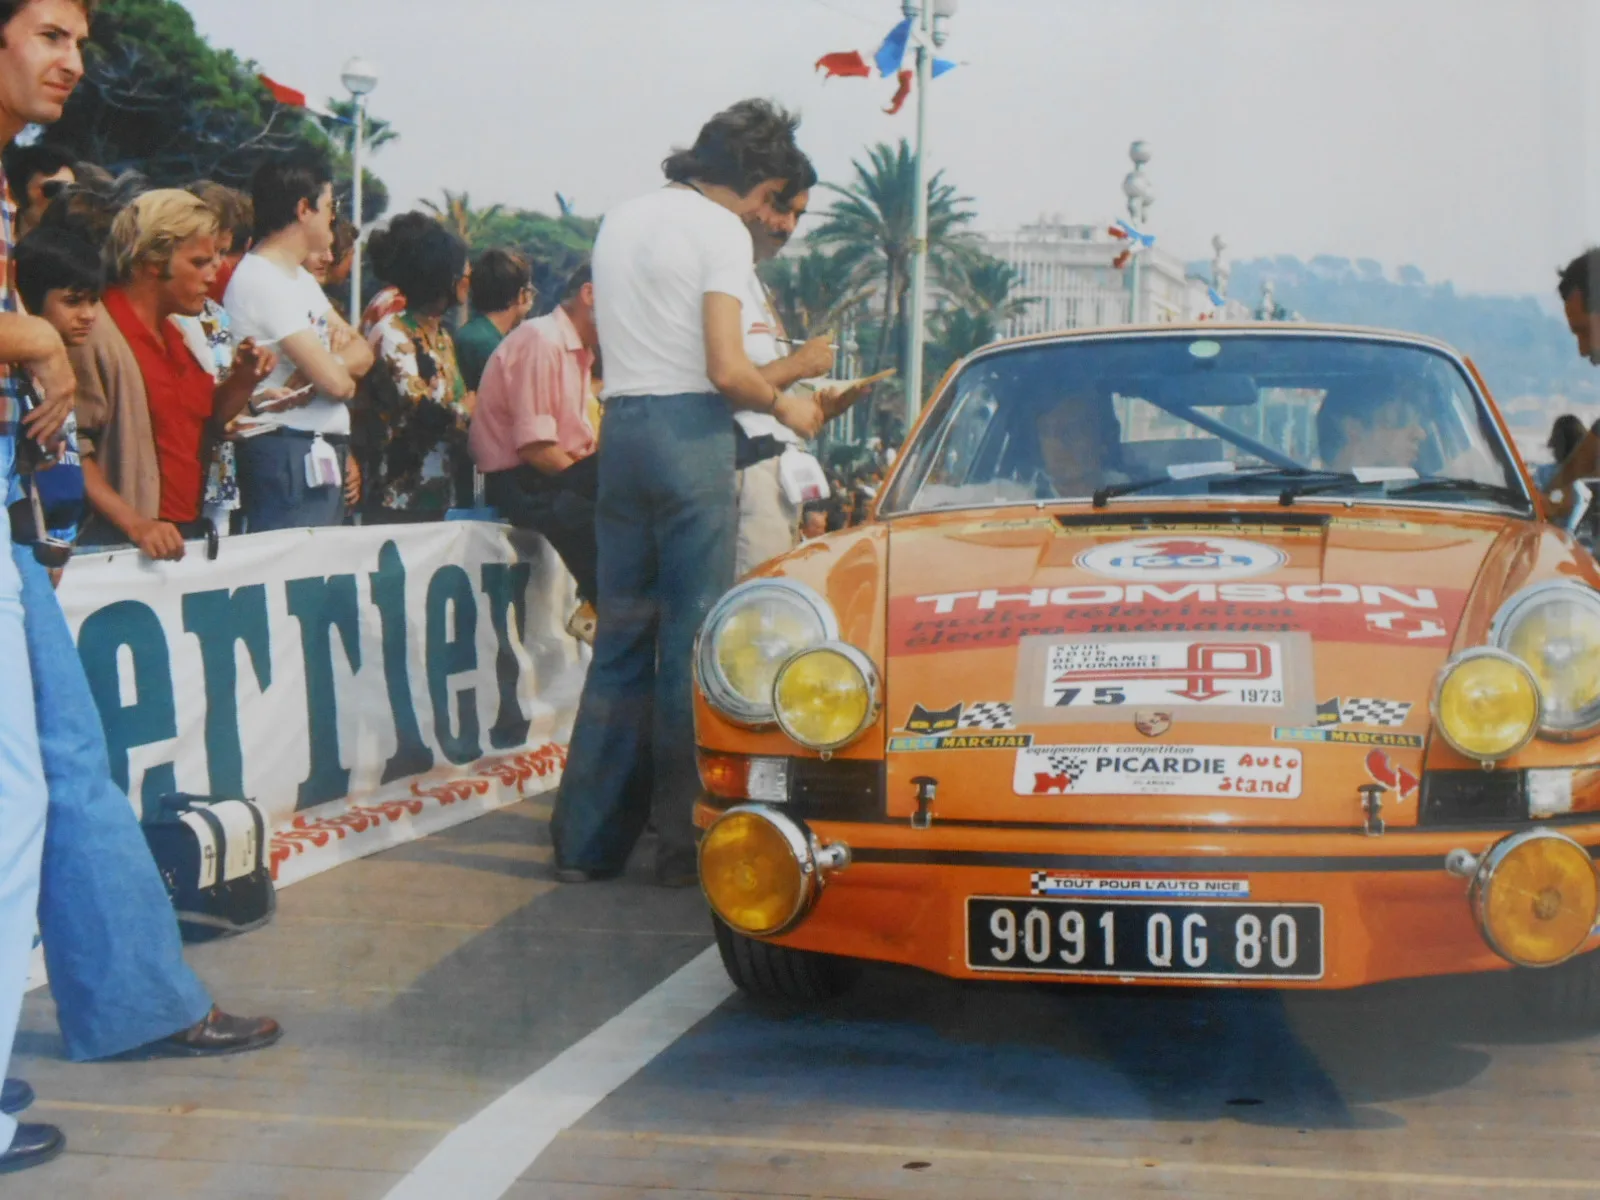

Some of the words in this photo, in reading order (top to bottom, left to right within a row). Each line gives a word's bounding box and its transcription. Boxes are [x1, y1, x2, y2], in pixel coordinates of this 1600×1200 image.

[916, 583, 1439, 615] THOMSON
[912, 610, 1041, 631] radio
[1052, 661, 1158, 671] AUTOMOBILE
[1082, 654, 1158, 662] FRANCE
[77, 539, 531, 822] errier
[1053, 686, 1126, 707] 75
[1239, 689, 1284, 704] 1973
[941, 734, 1027, 748] MARCHAL
[1330, 730, 1418, 746] MARCHAL
[1096, 756, 1226, 775] PICARDIE
[1237, 752, 1300, 769] Auto
[1217, 774, 1293, 794] stand
[1053, 879, 1094, 890] TOUT
[1100, 880, 1142, 891] POUR
[1145, 881, 1200, 891] L'AUTO
[1204, 882, 1242, 892] NICE
[989, 907, 1116, 966] 9091
[1146, 912, 1208, 969] QG
[1234, 913, 1298, 969] 80
